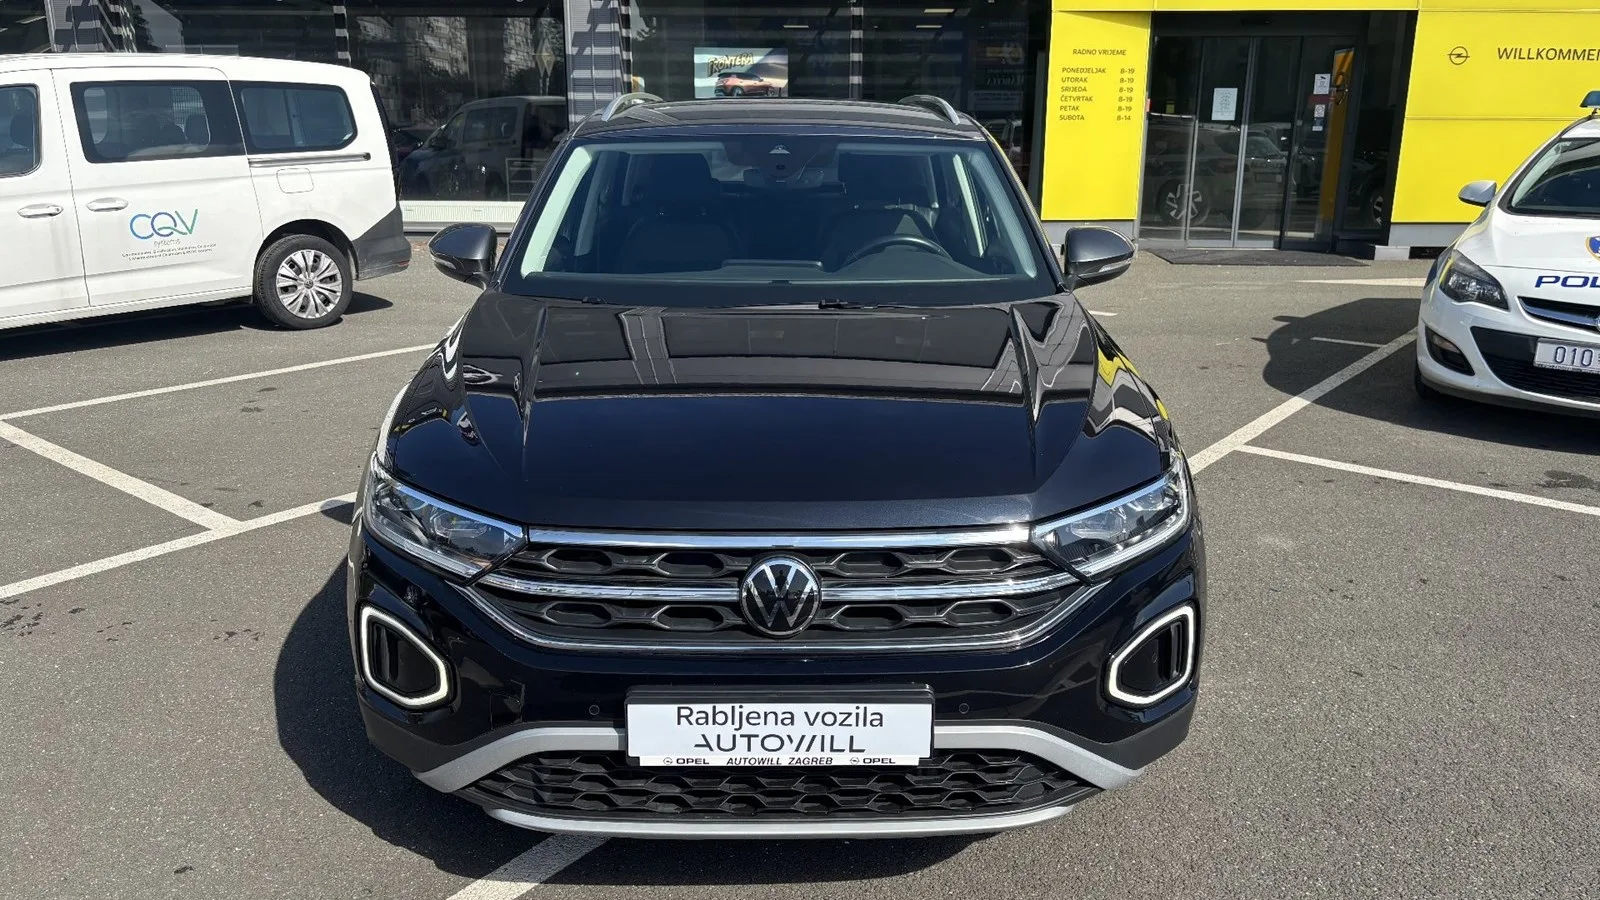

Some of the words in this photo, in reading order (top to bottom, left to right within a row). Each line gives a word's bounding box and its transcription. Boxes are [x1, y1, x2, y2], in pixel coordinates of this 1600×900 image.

[707, 53, 754, 77] FRONTERA
[1060, 94, 1093, 103] ČETVRTAK
[129, 208, 198, 239] CQV
[1554, 346, 1593, 368] 010
[676, 705, 795, 731] Rabljena
[804, 706, 884, 728] vozila
[693, 733, 866, 753] AUTOWILL
[676, 757, 710, 765] OPEL
[726, 757, 783, 766] AUTOWILL
[787, 757, 833, 766] ZAGREB
[863, 757, 896, 765] OPEL
